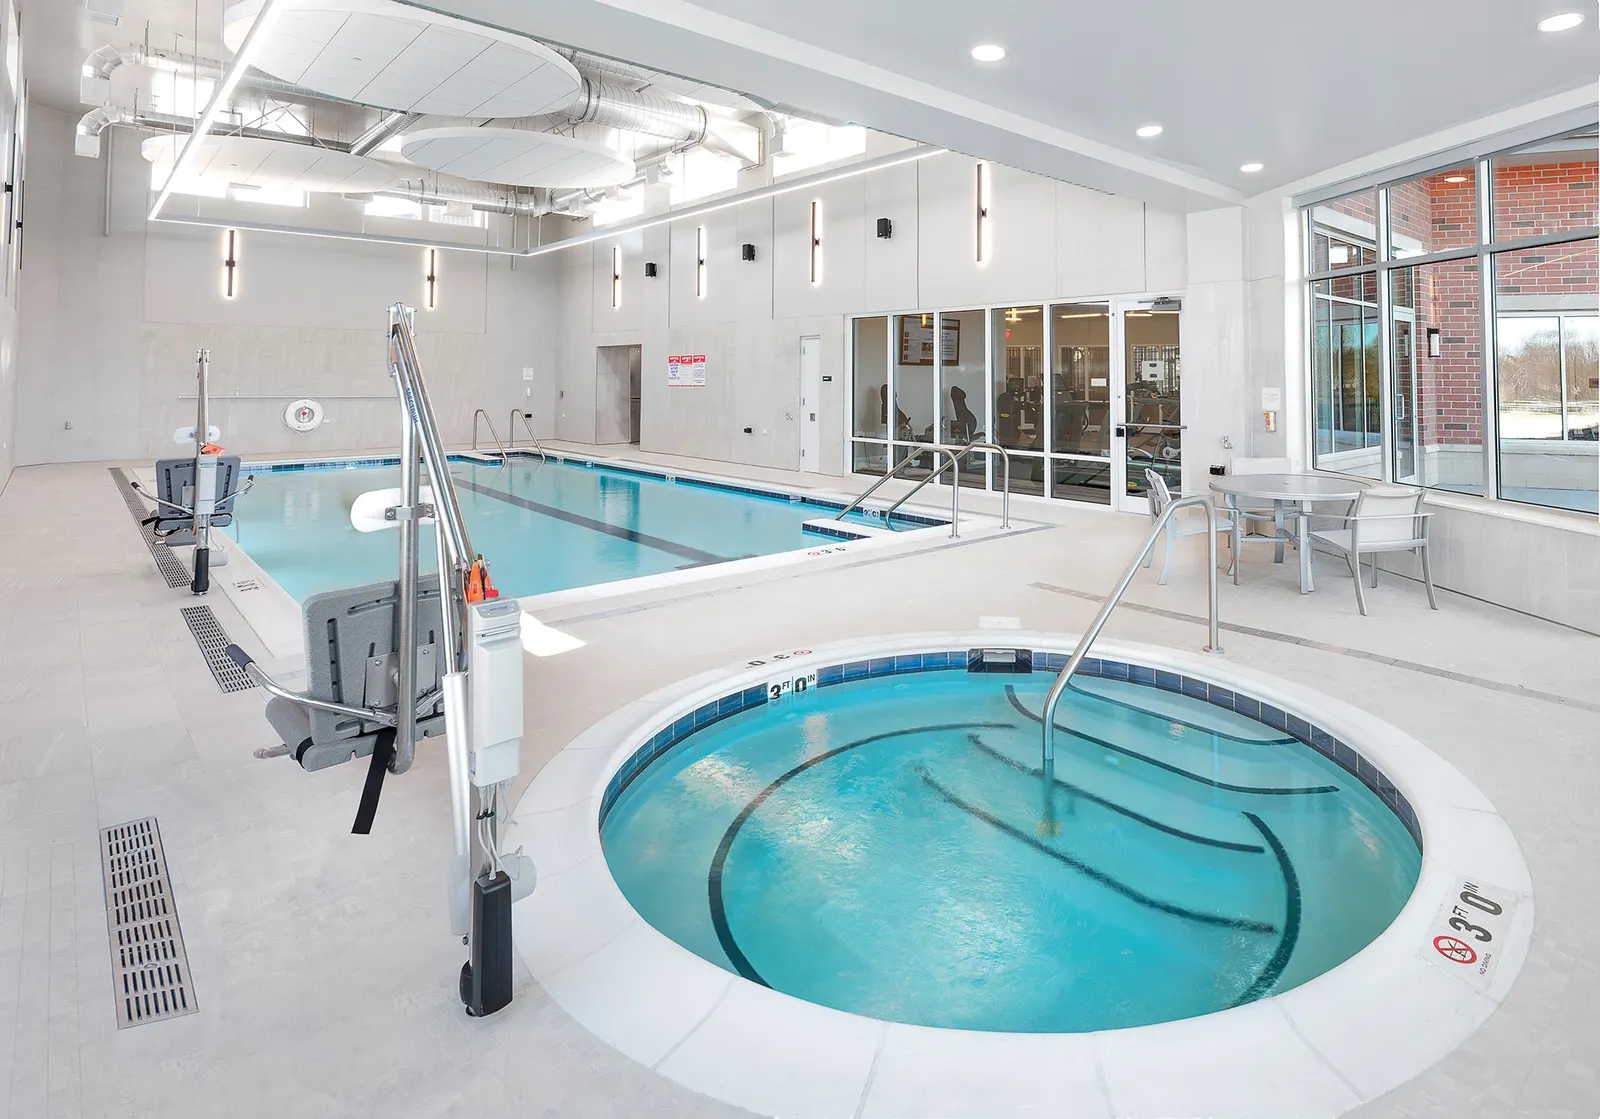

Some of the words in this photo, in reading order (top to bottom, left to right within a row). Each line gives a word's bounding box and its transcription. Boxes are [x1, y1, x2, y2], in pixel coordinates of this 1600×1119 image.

[406, 387, 419, 424] SPECTRUM
[770, 684, 782, 700] 3
[1459, 890, 1503, 916] 0
[1448, 916, 1493, 943] 3
[1481, 952, 1492, 969] DIVING
[1479, 967, 1487, 976] NO
